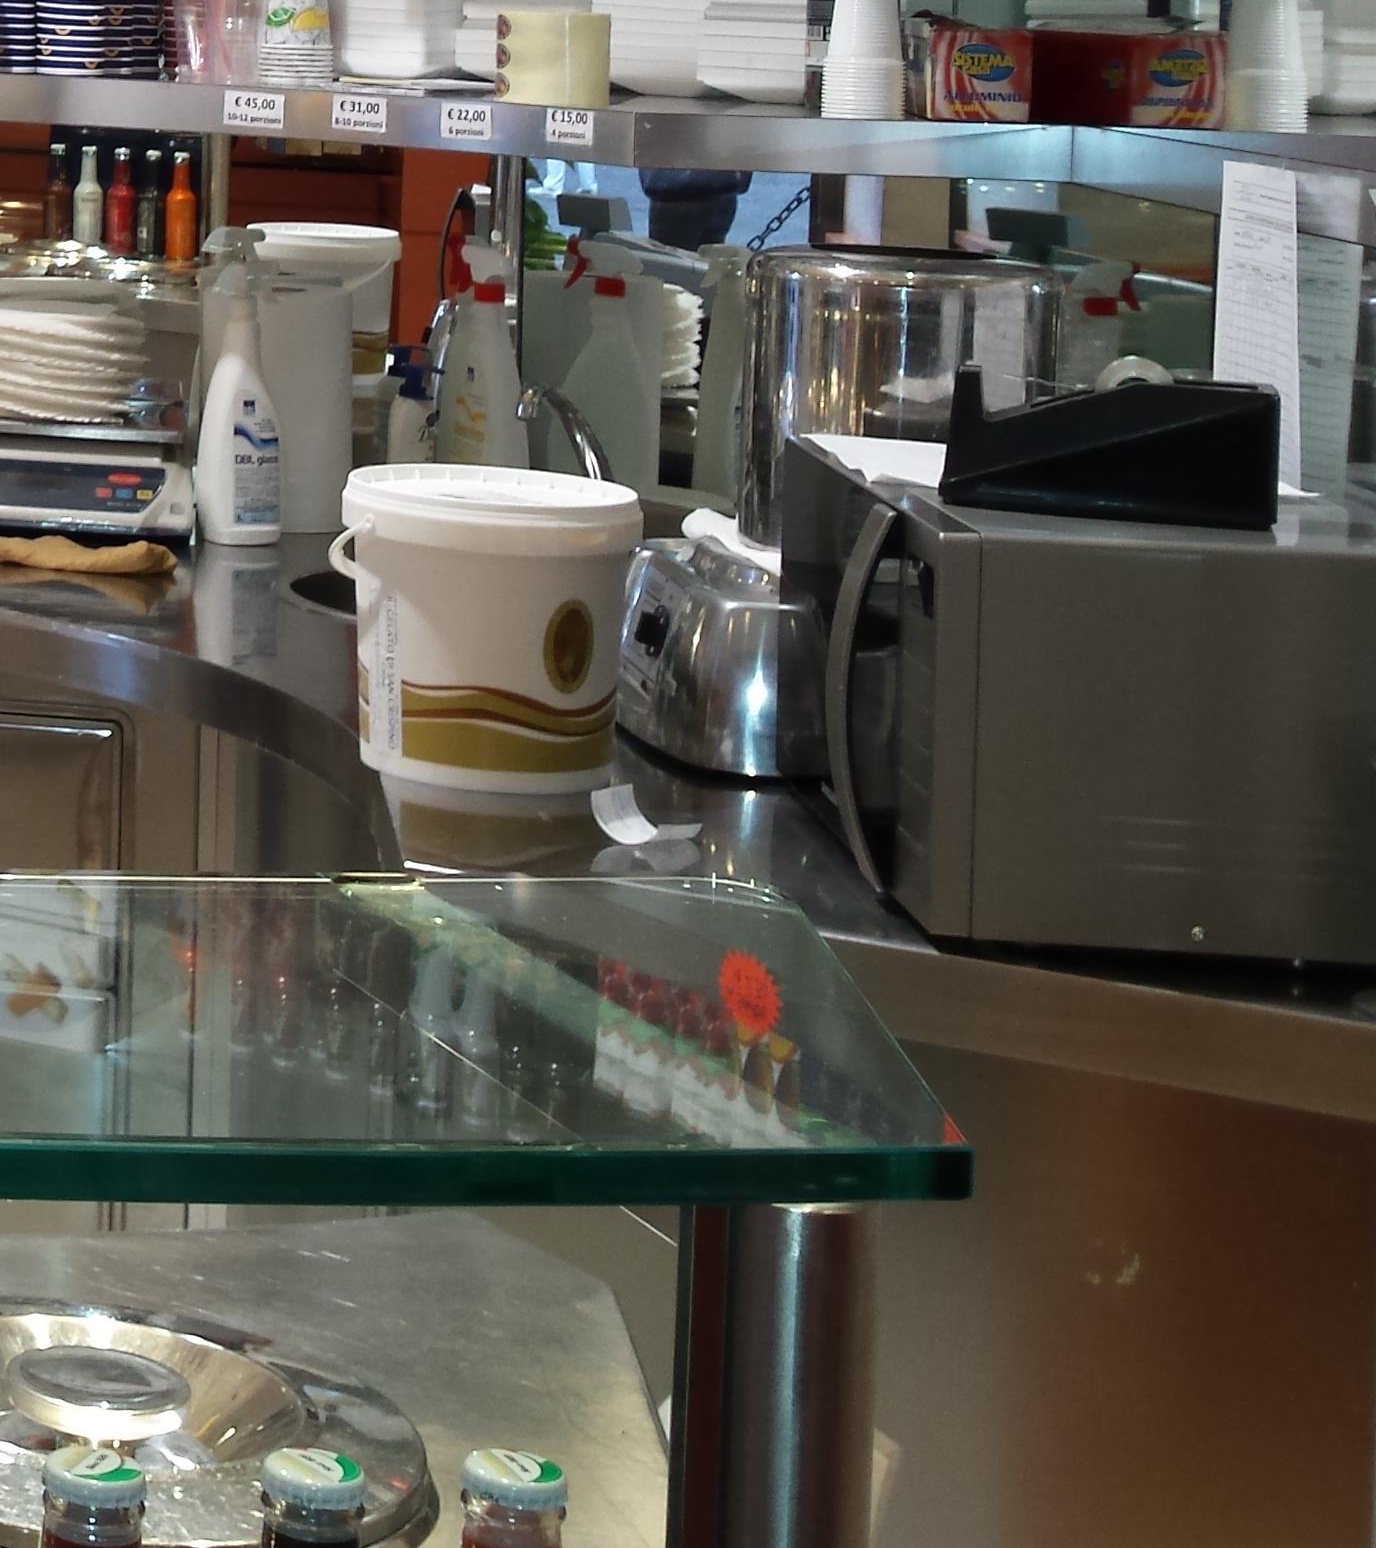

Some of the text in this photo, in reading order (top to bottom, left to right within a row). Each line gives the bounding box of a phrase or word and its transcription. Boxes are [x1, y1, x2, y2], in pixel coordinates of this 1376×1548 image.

[952, 52, 1014, 69] SISTEMA
[235, 96, 276, 111] € 45,00
[340, 100, 380, 114] € 31,00
[250, 114, 282, 125] porzioni
[448, 108, 486, 123] € 22,00
[551, 110, 588, 125] € 15,00
[353, 118, 384, 129] porzioni
[455, 127, 485, 137] porzioni
[557, 129, 586, 140] porzioni
